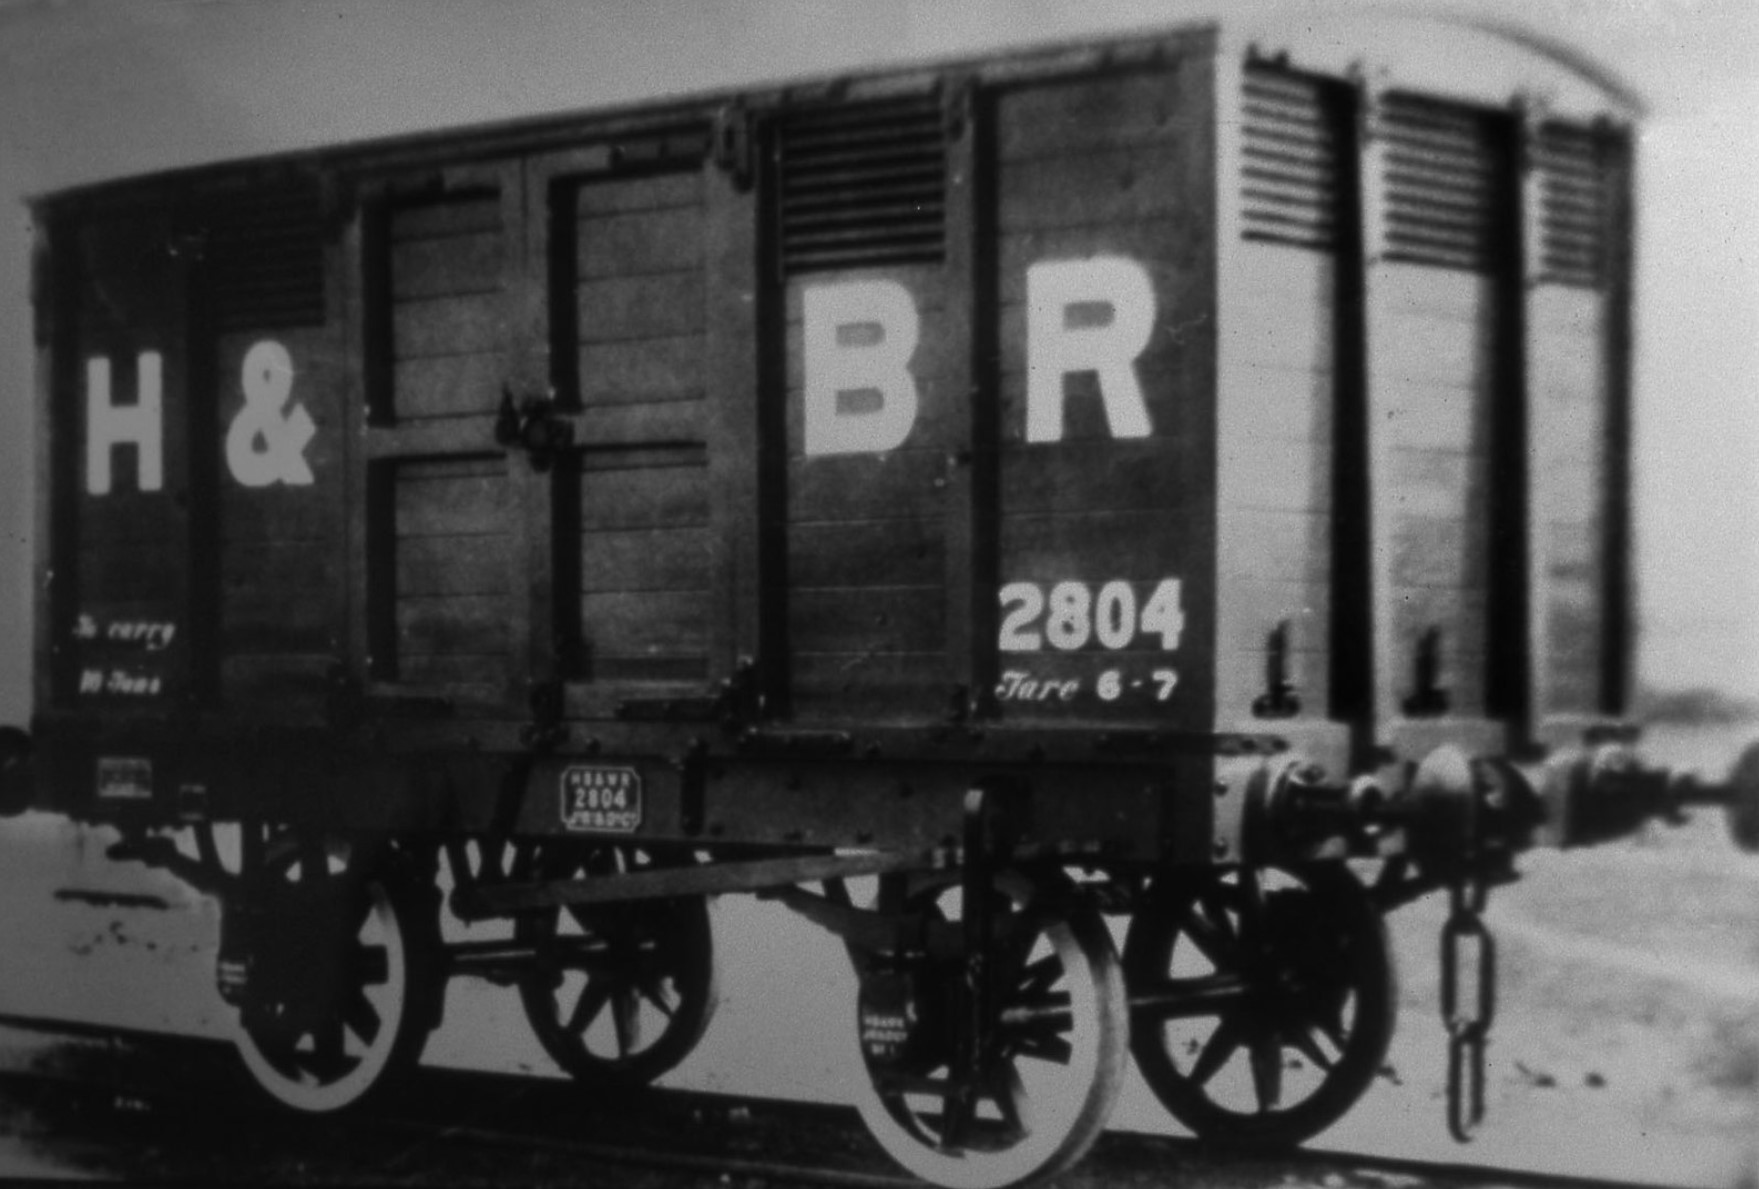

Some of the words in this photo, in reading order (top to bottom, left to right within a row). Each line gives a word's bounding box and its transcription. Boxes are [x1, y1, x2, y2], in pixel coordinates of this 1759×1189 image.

[86, 351, 163, 495] H
[225, 341, 316, 487] &
[802, 279, 920, 456] B
[1025, 253, 1156, 443] R
[998, 577, 1185, 652] 2804
[994, 669, 1080, 701] Tare
[574, 787, 627, 810] 2804
